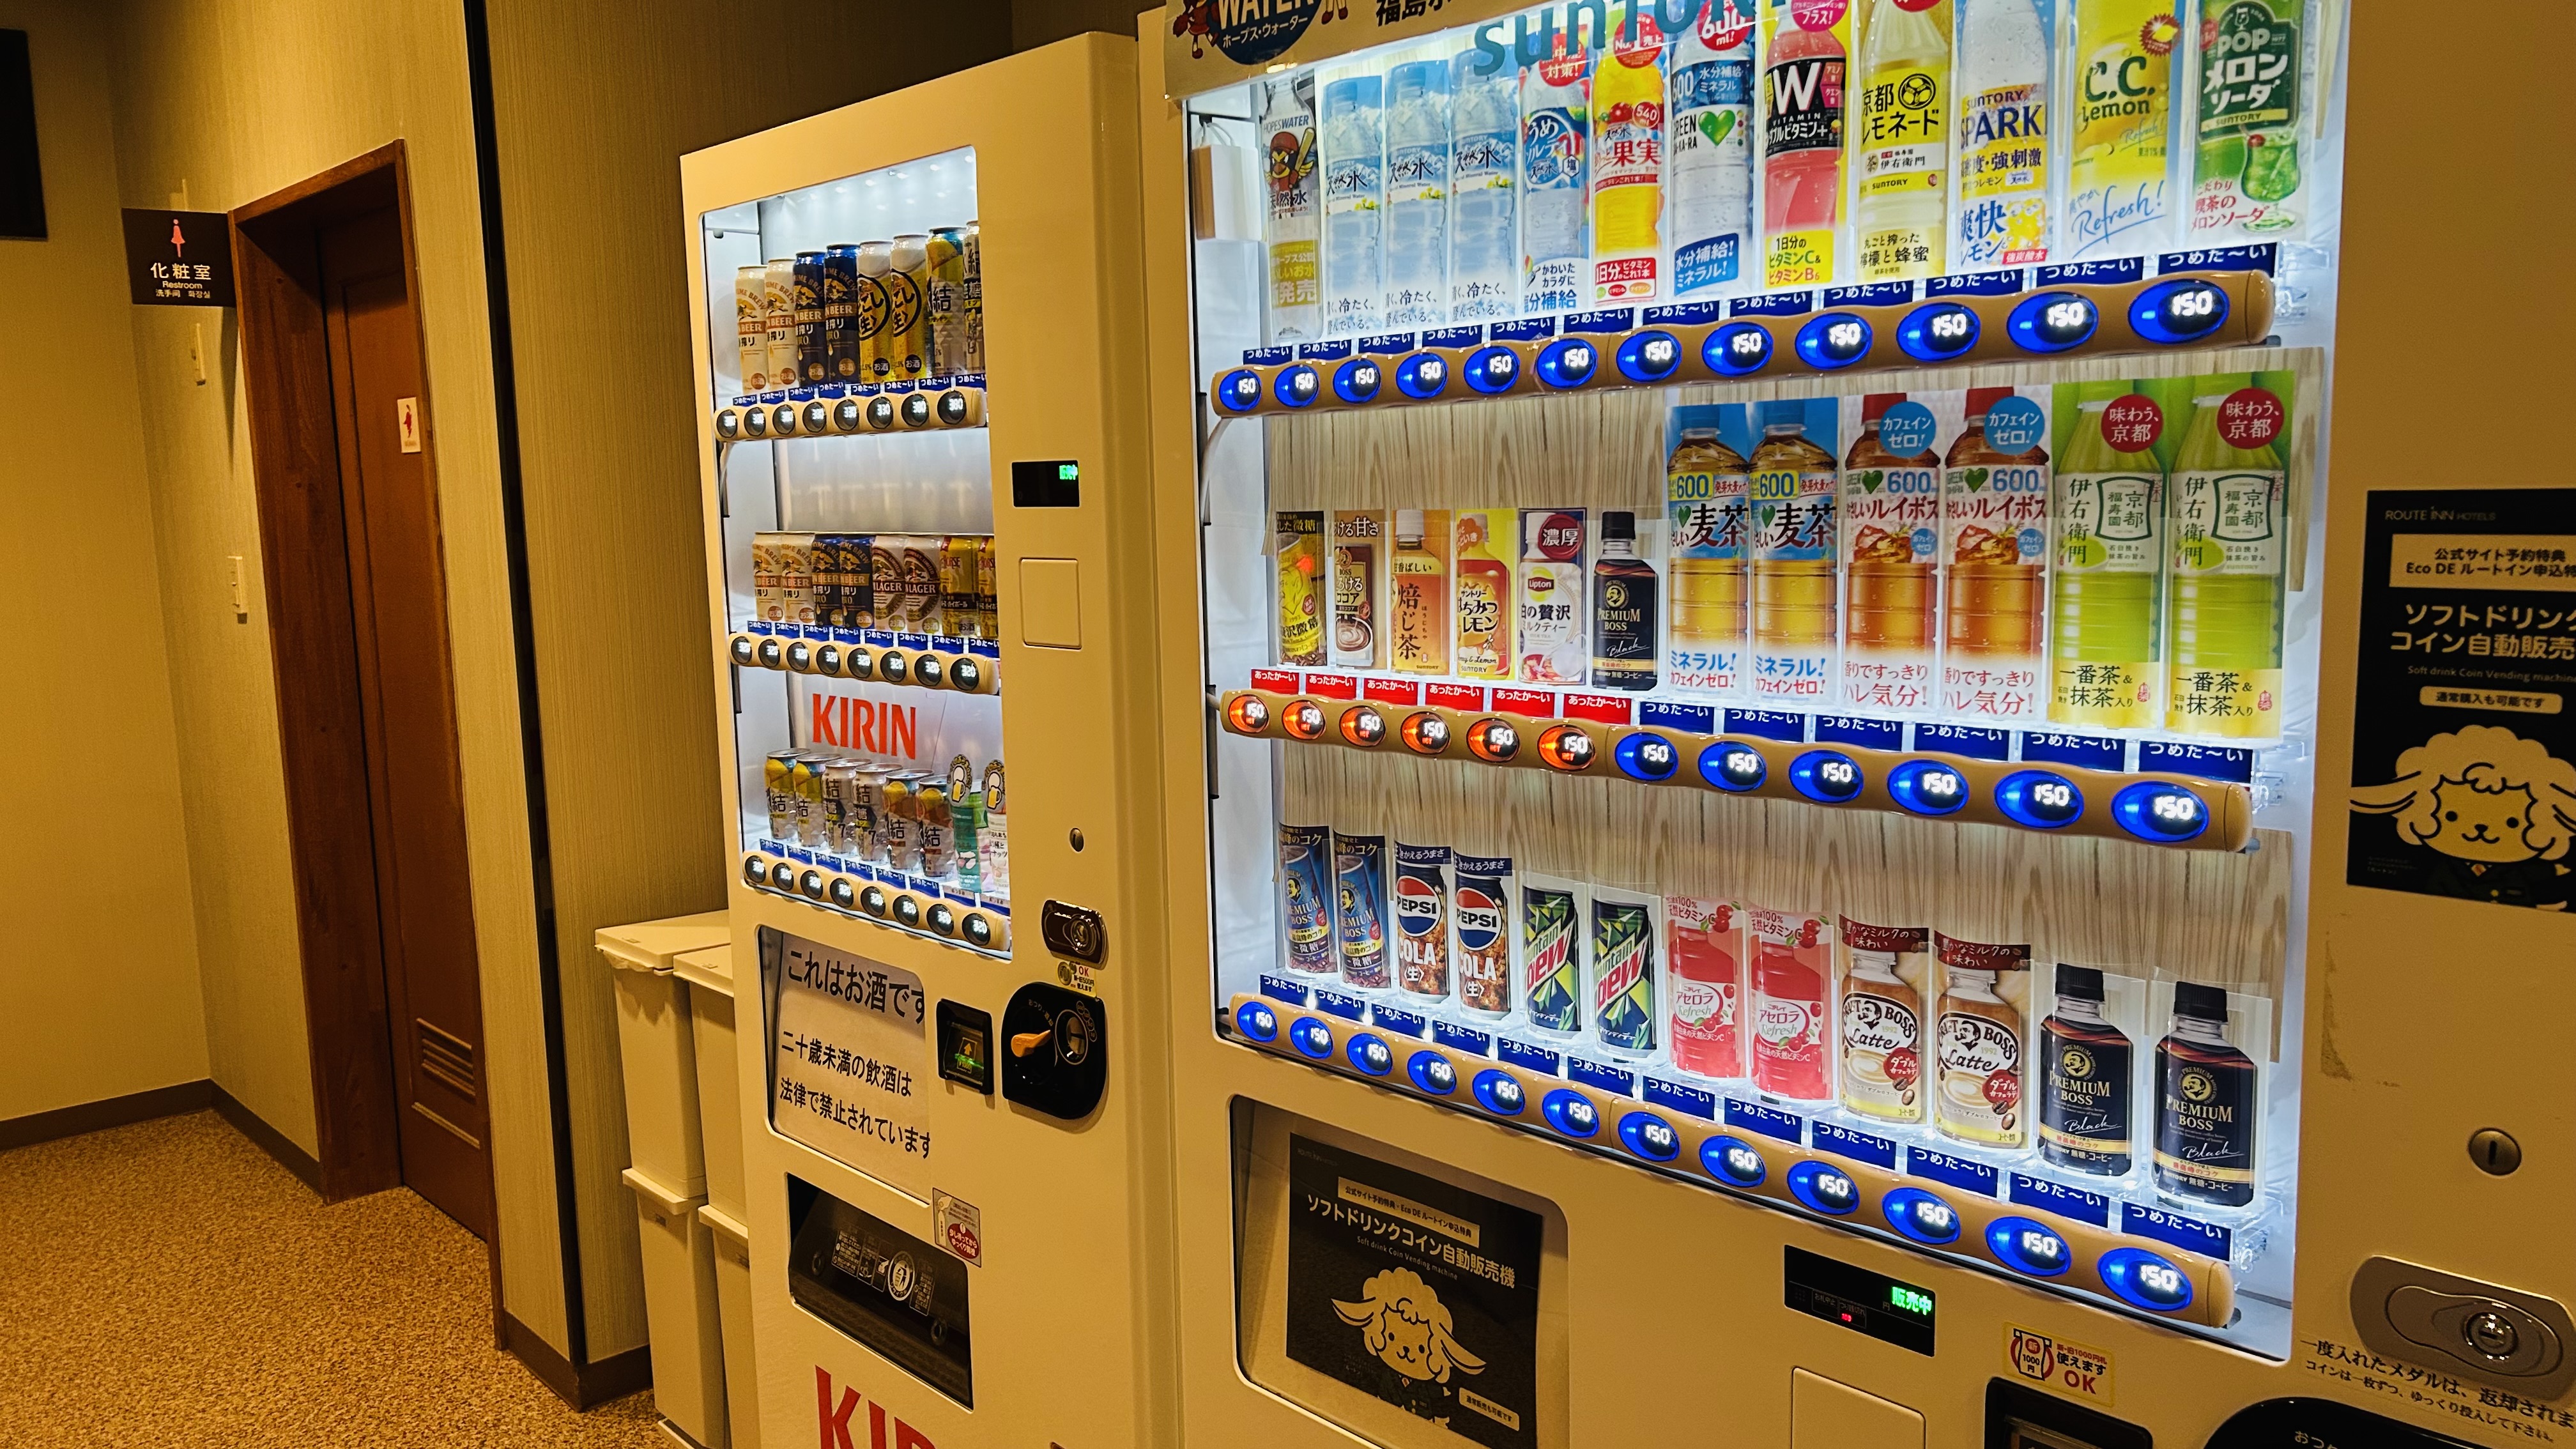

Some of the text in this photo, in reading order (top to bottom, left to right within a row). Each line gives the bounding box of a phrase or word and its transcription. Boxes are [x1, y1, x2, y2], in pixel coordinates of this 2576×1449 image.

[2216, 27, 2271, 58] POP
[1699, 65, 1743, 81] 水分補給
[2203, 53, 2288, 94] メロン
[1699, 80, 1738, 93] ミネラル
[1772, 61, 1821, 116] W
[1862, 83, 1894, 118] 京都
[1966, 89, 2023, 112] SUNTORY
[2210, 79, 2281, 115] ソーダ
[1636, 105, 1657, 121] 540
[1772, 113, 1821, 126] VITAMIN
[2081, 98, 2151, 133] Lemon
[2216, 112, 2262, 126] SUNTORY
[1454, 145, 1501, 174] 天然水
[1613, 138, 1662, 167] 果実
[1880, 156, 1926, 169] 伊右衛門
[1871, 178, 1908, 190] SUNTORY
[1959, 200, 2007, 243] 爽快
[1775, 237, 1807, 251] 1日分の
[1675, 240, 1734, 272] 水分補給!
[2005, 250, 2045, 264] 強炭酸水
[150, 262, 211, 280] 化粧室
[1542, 262, 1575, 276] かわいた
[1675, 264, 1728, 289] ミネラル!
[162, 280, 203, 290] Restroom
[1542, 275, 1575, 288] カラダに
[2172, 290, 2213, 316] 150
[2047, 302, 2085, 328] 150
[1645, 340, 1672, 362] 150
[1489, 355, 1512, 374] 150
[1238, 378, 1256, 394] 150
[1883, 416, 1932, 432] カフェイン
[2110, 424, 2151, 443] 京都
[1888, 433, 1925, 448] ゼロ!
[1676, 473, 1709, 498] 600
[2122, 489, 2145, 530] 京都
[2384, 509, 2427, 520] ROUTE
[1774, 502, 1837, 548] 麦茶
[2067, 478, 2092, 566] 伊右衛門
[1542, 528, 1580, 547] 濃厚
[2434, 548, 2566, 562] 公式サイト予約特典
[2406, 562, 2431, 574] Eco
[2435, 563, 2455, 574] DE
[1528, 579, 1552, 589] Lipton
[1397, 583, 1422, 661] 焙じ茶
[1462, 615, 1499, 633] レモン
[1597, 608, 1641, 622] PREMIUM
[1604, 621, 1627, 632] BOSS
[1670, 653, 1736, 671] ミネラル!
[2407, 665, 2427, 675] Soft
[2430, 666, 2457, 677] drink
[2459, 668, 2483, 678] Coin
[1670, 671, 1736, 689] カフェインゼロ!
[812, 693, 916, 760] KIRIN
[1360, 714, 1381, 731] 150
[1490, 727, 1514, 746] 150
[1823, 762, 1852, 783] 150
[2034, 783, 2070, 807] 150
[1397, 894, 1437, 914] PEPSI
[1399, 937, 1437, 965] COLA
[1078, 965, 1089, 977] OK
[1675, 991, 1714, 1006] アセロラ
[1255, 1011, 1273, 1028] 150
[1678, 1005, 1712, 1016] Refresh
[1848, 1028, 1900, 1050] Latte
[1368, 1043, 1389, 1062] 150
[781, 1030, 912, 1098] 二十歳未満の飲酒は
[2166, 1092, 2234, 1124] PREMIUM
[779, 1077, 931, 1160] 法律で禁止されています
[2178, 1113, 2214, 1131] BOSS
[1645, 1124, 1671, 1146] 150
[2182, 1142, 2244, 1162] Black
[1818, 1174, 1850, 1197] 150
[1307, 1193, 1516, 1289] ソフトドリンクコイン自動販売機
[1357, 1236, 1458, 1280] Soft drink Coin Vending machine
[2140, 1263, 2182, 1293] 150
[1891, 1285, 1933, 1315] 販売中
[2022, 1354, 2041, 1366] 1000
[2056, 1351, 2107, 1376] 使えます
[2064, 1369, 2097, 1395] OK
